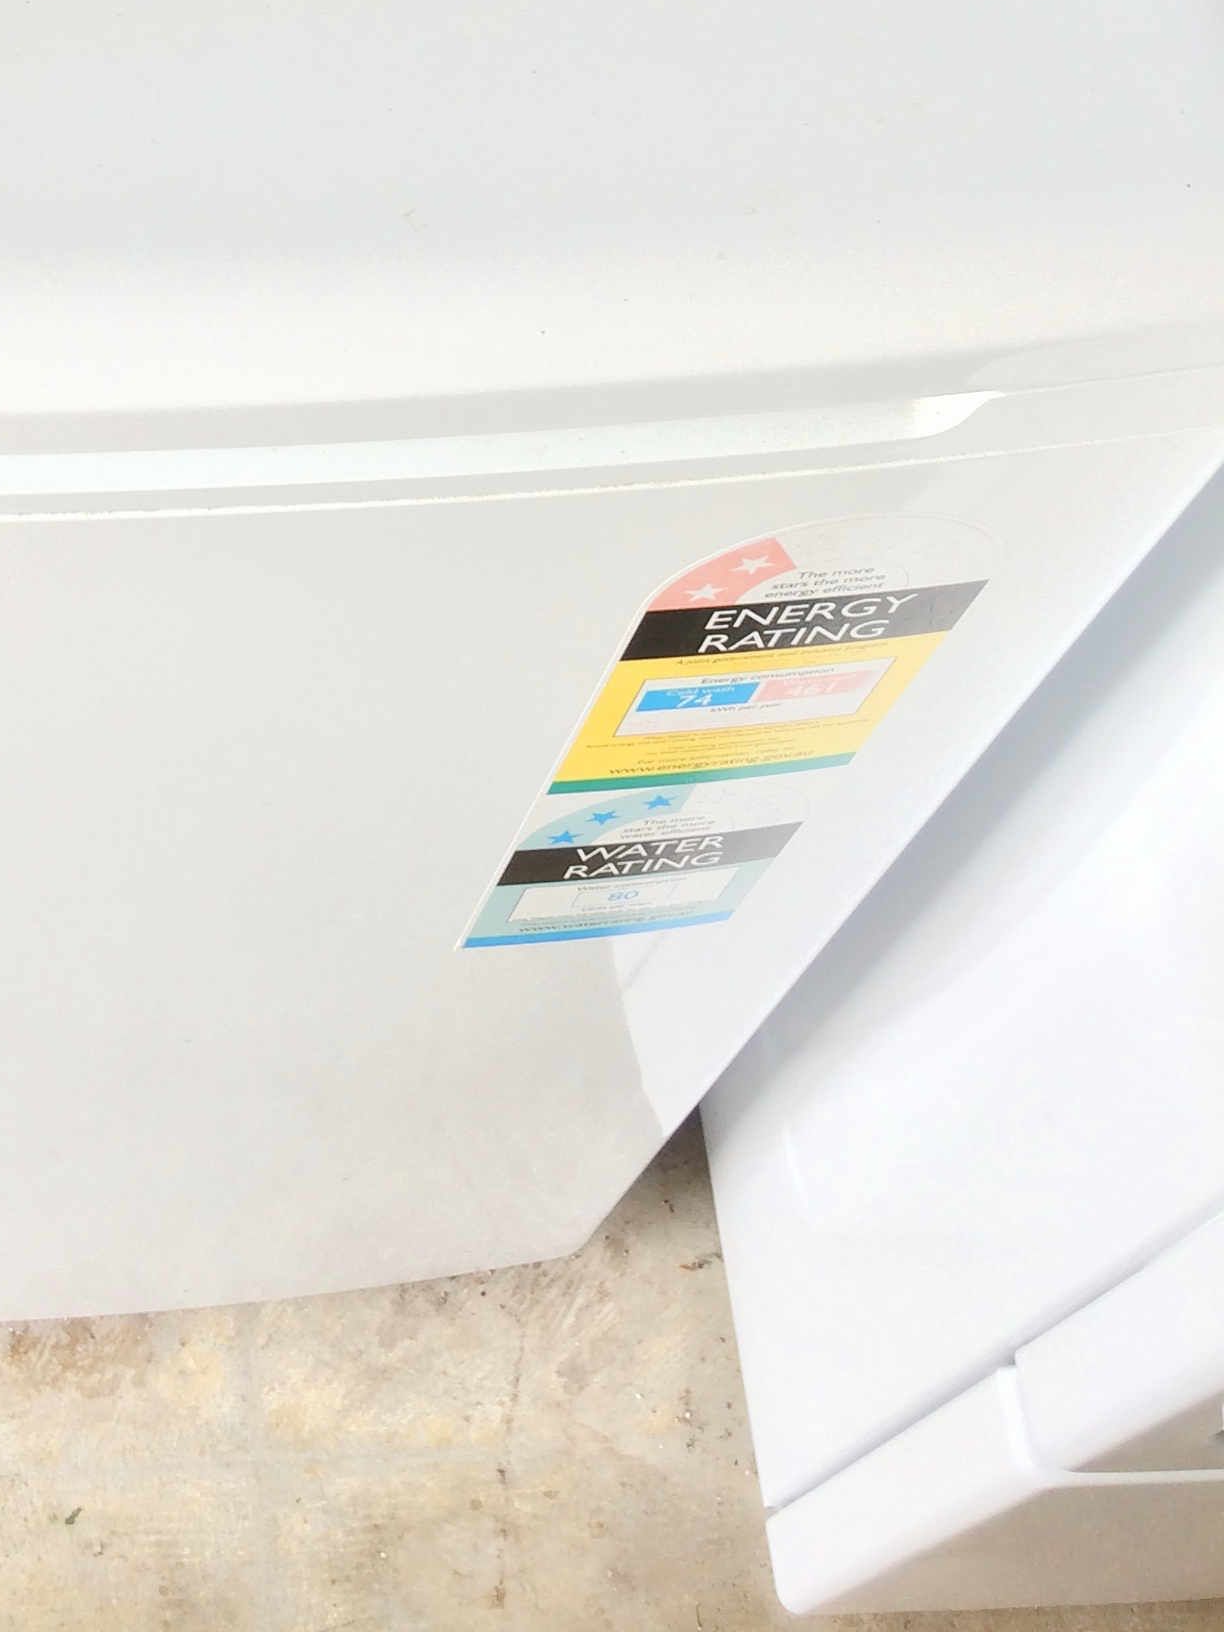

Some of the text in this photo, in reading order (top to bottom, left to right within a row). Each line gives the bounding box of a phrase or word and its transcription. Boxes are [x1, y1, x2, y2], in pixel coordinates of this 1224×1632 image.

[704, 592, 920, 631] ENERGY
[697, 619, 890, 653] RATING
[676, 694, 712, 708] 74
[576, 835, 725, 862] WATER
[562, 851, 723, 880] RATING
[607, 890, 639, 901] 80
